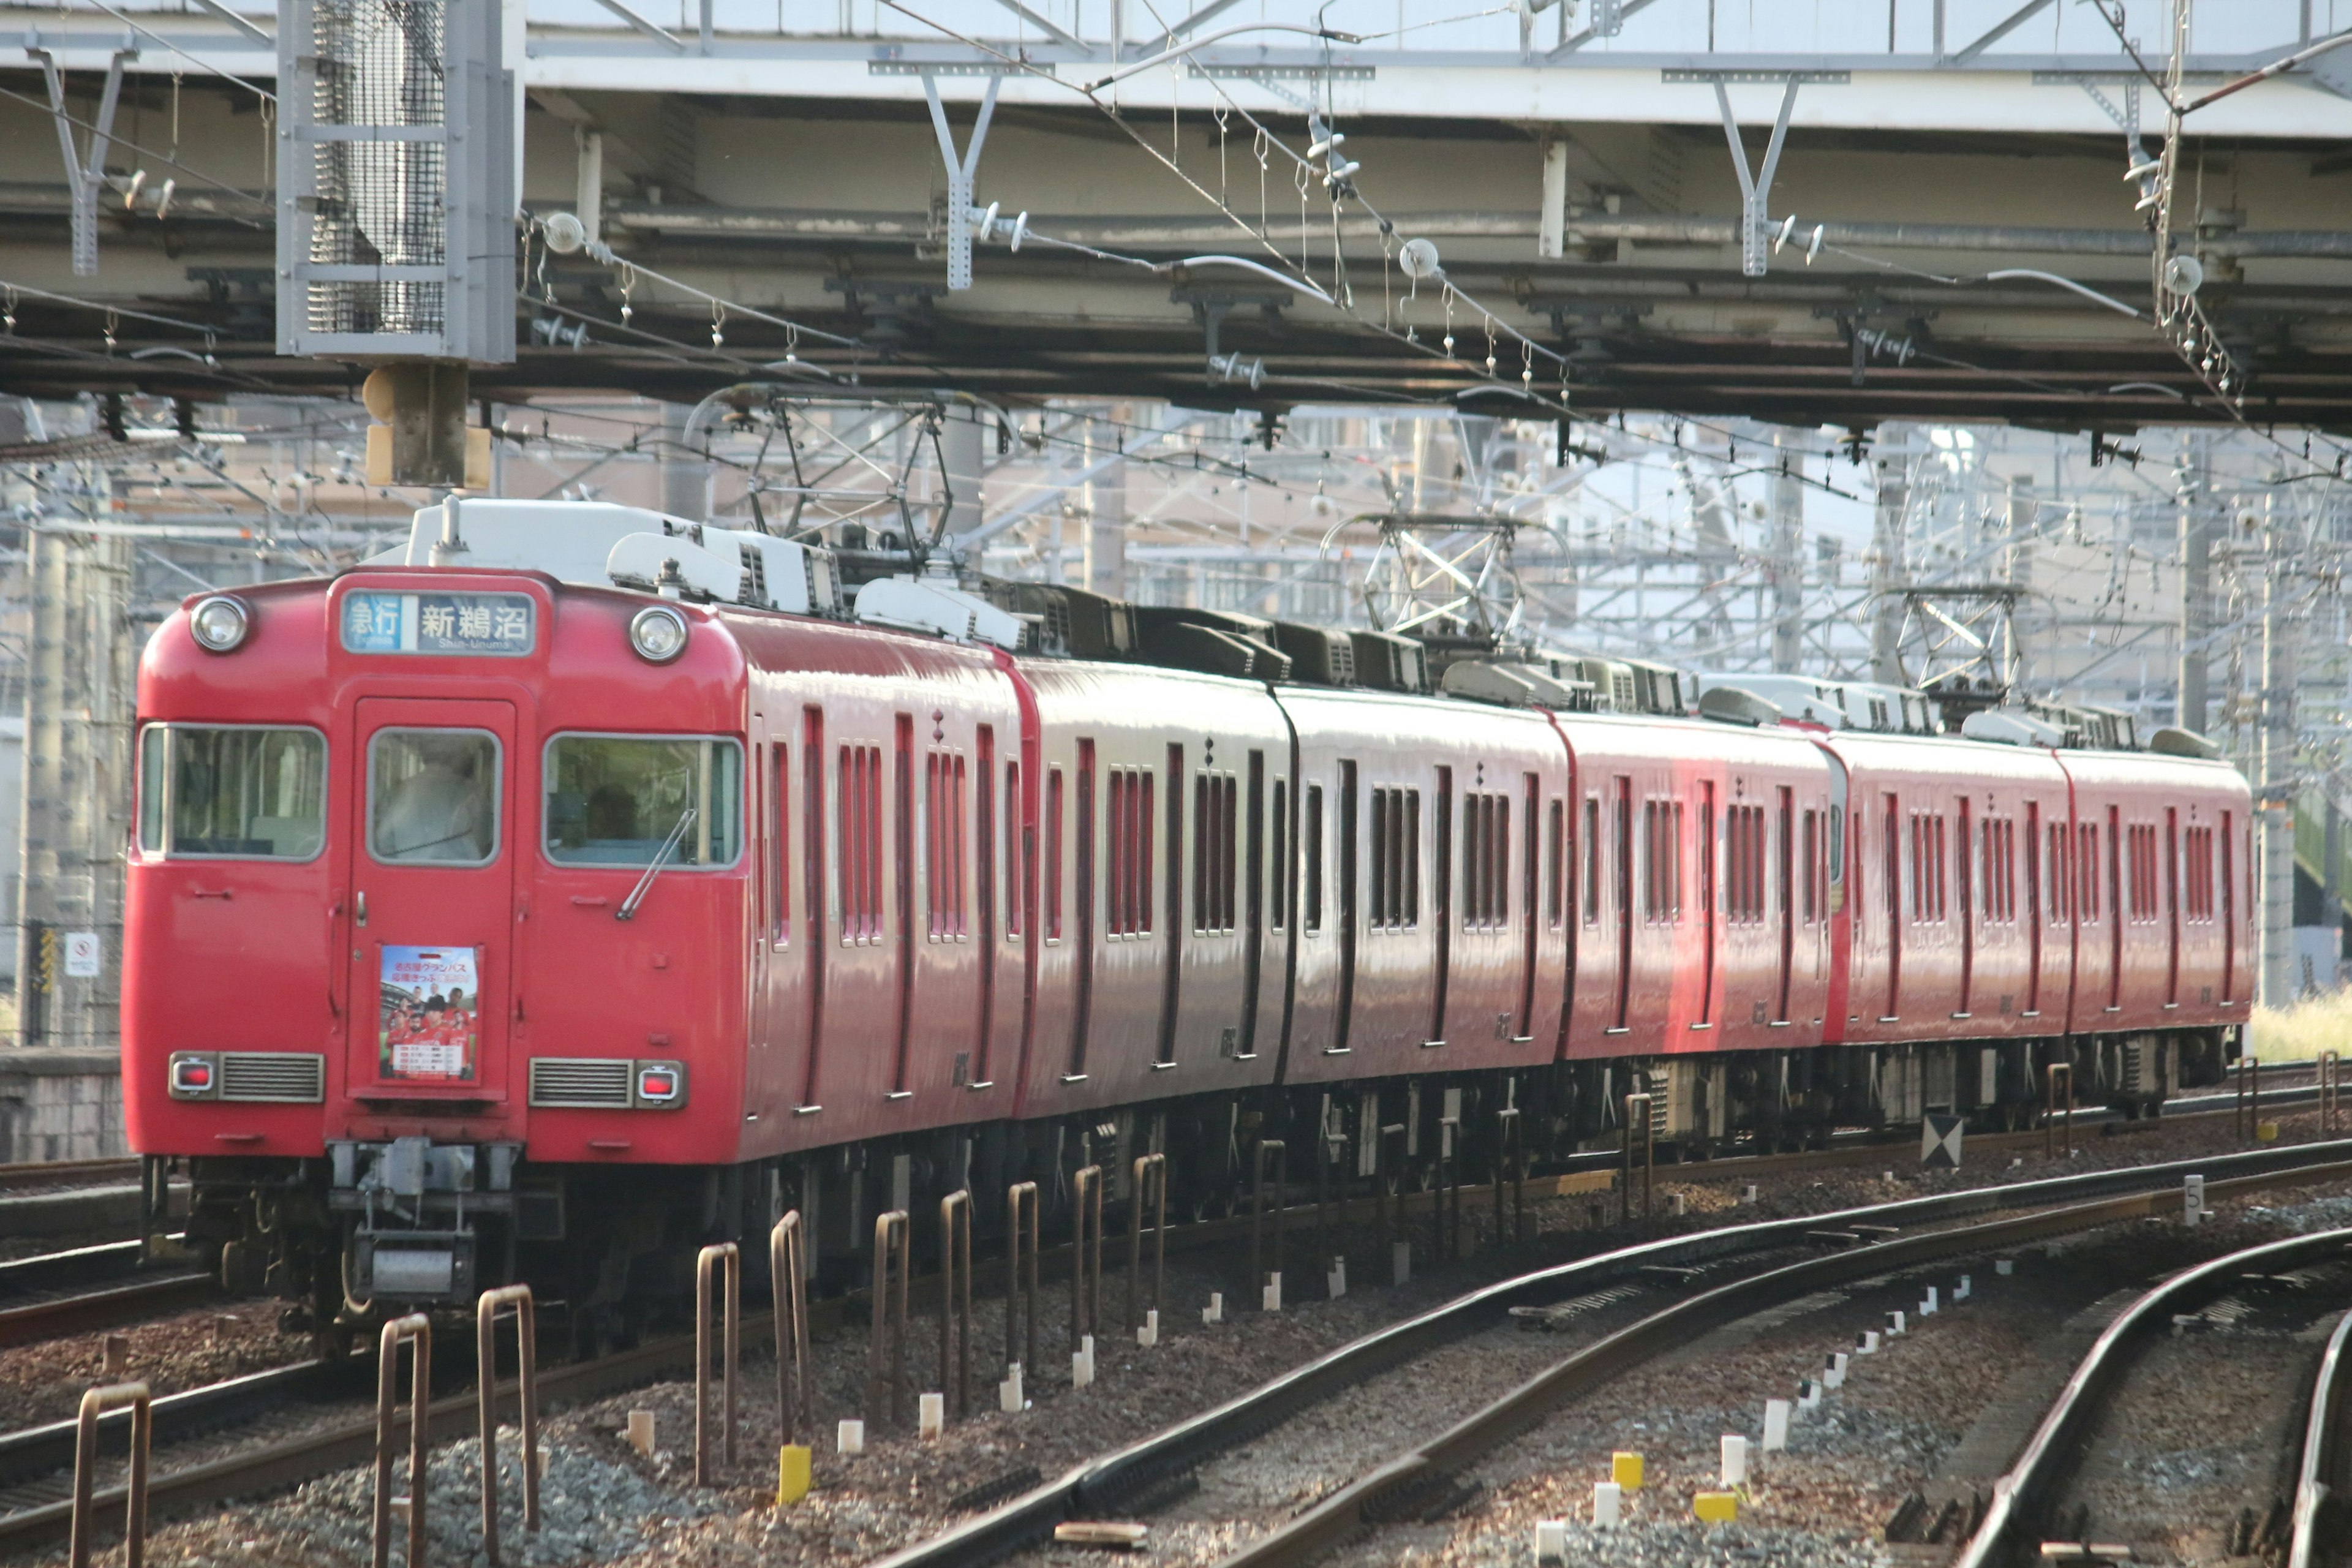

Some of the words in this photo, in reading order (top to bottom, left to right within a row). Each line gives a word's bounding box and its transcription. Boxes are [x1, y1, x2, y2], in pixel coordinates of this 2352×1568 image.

[351, 601, 398, 635] 急行
[422, 605, 527, 639] 新鵜沼
[439, 638, 509, 649] Shin-Unuma
[2188, 1185, 2200, 1208] 5
